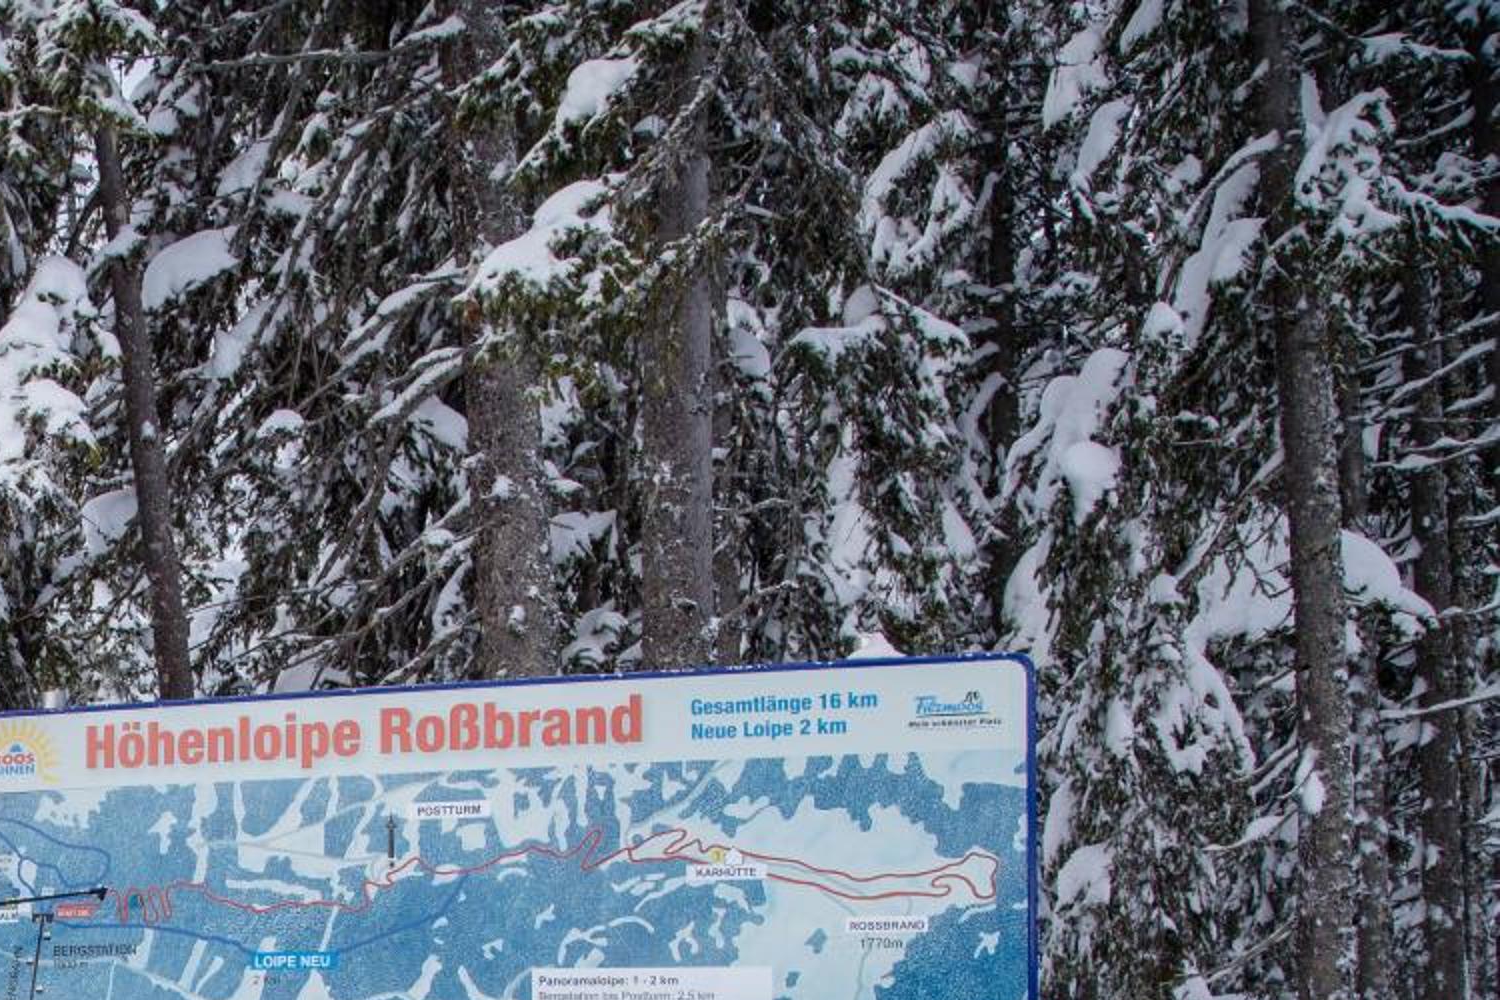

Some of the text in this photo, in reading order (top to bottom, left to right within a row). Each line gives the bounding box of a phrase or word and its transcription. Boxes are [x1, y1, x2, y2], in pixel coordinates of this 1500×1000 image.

[691, 692, 878, 715] Gesamtlänge 16 km
[85, 694, 642, 769] Höhenloipe Roßbrand
[691, 717, 847, 740] Neue Loipe 2 km
[417, 805, 483, 816] POSTTURM
[695, 865, 757, 877] KARHÜTTE
[849, 920, 925, 931] ROSSBRAND
[860, 937, 903, 949] 1770m
[53, 944, 137, 957] BERGSTATION
[255, 955, 331, 968] LOIPE NEU
[538, 976, 629, 987] Panoramaloipe:
[650, 976, 656, 985] 2
[660, 975, 679, 985] km
